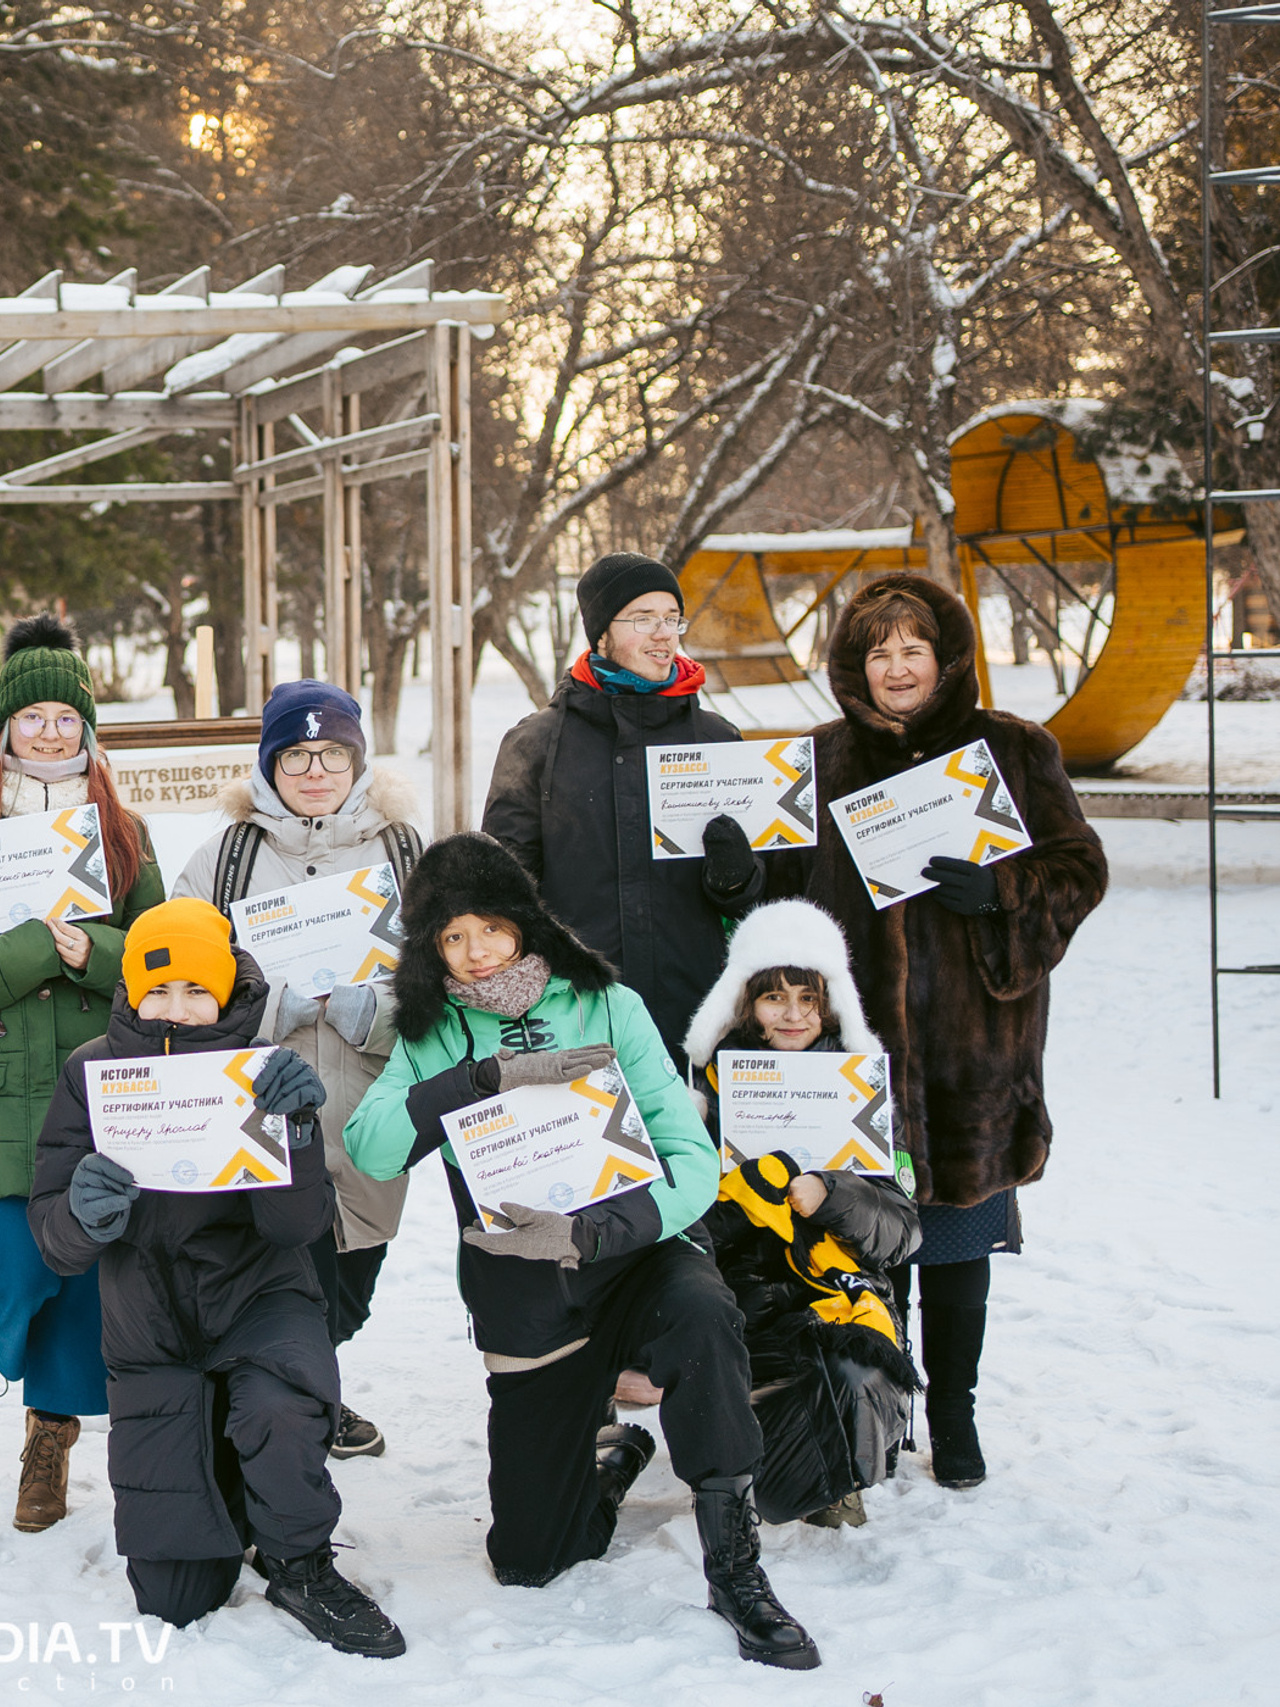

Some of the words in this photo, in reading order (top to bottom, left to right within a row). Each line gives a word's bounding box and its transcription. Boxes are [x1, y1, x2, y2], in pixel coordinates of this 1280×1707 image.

[660, 752, 701, 762] ИСТОРИЯ
[660, 763, 707, 773] КУЗБАССА
[660, 781, 713, 790] СЕРТИФИКАТ
[716, 777, 763, 786] УЧАСТНИКА
[130, 787, 154, 802] ПО
[845, 790, 884, 814] ИСТОРИЯ
[850, 799, 895, 824] КУЗБАССА
[856, 814, 906, 839] СЕРТИФИКАТ
[908, 794, 953, 818] УЧАСТНИКА
[8, 847, 53, 861] УЧАСТНИКА
[246, 896, 285, 915] ИСТОРИЯ
[248, 906, 294, 926] КУЗБАССА
[251, 921, 303, 942] СЕРТИФИКАТ
[305, 909, 351, 927] УЧАСТНИКА
[732, 1060, 775, 1069] ИСТОРИЯ
[101, 1067, 150, 1081] ИСТОРИЯ
[732, 1071, 782, 1081] КУЗБАССА
[102, 1080, 158, 1094] КУЗБАССА
[732, 1090, 787, 1099] СЕРТИФИКАТ
[791, 1091, 838, 1099] УЧАСТНИКА
[103, 1102, 164, 1113] СЕРТИФИКАТ
[168, 1096, 223, 1109] УЧАСТНИКА
[458, 1104, 504, 1130] ИСТОРИЯ
[463, 1114, 515, 1142] КУЗБАССА
[470, 1132, 527, 1160] СЕРТИФИКАТ
[528, 1112, 580, 1138] УЧАСТНИКА
